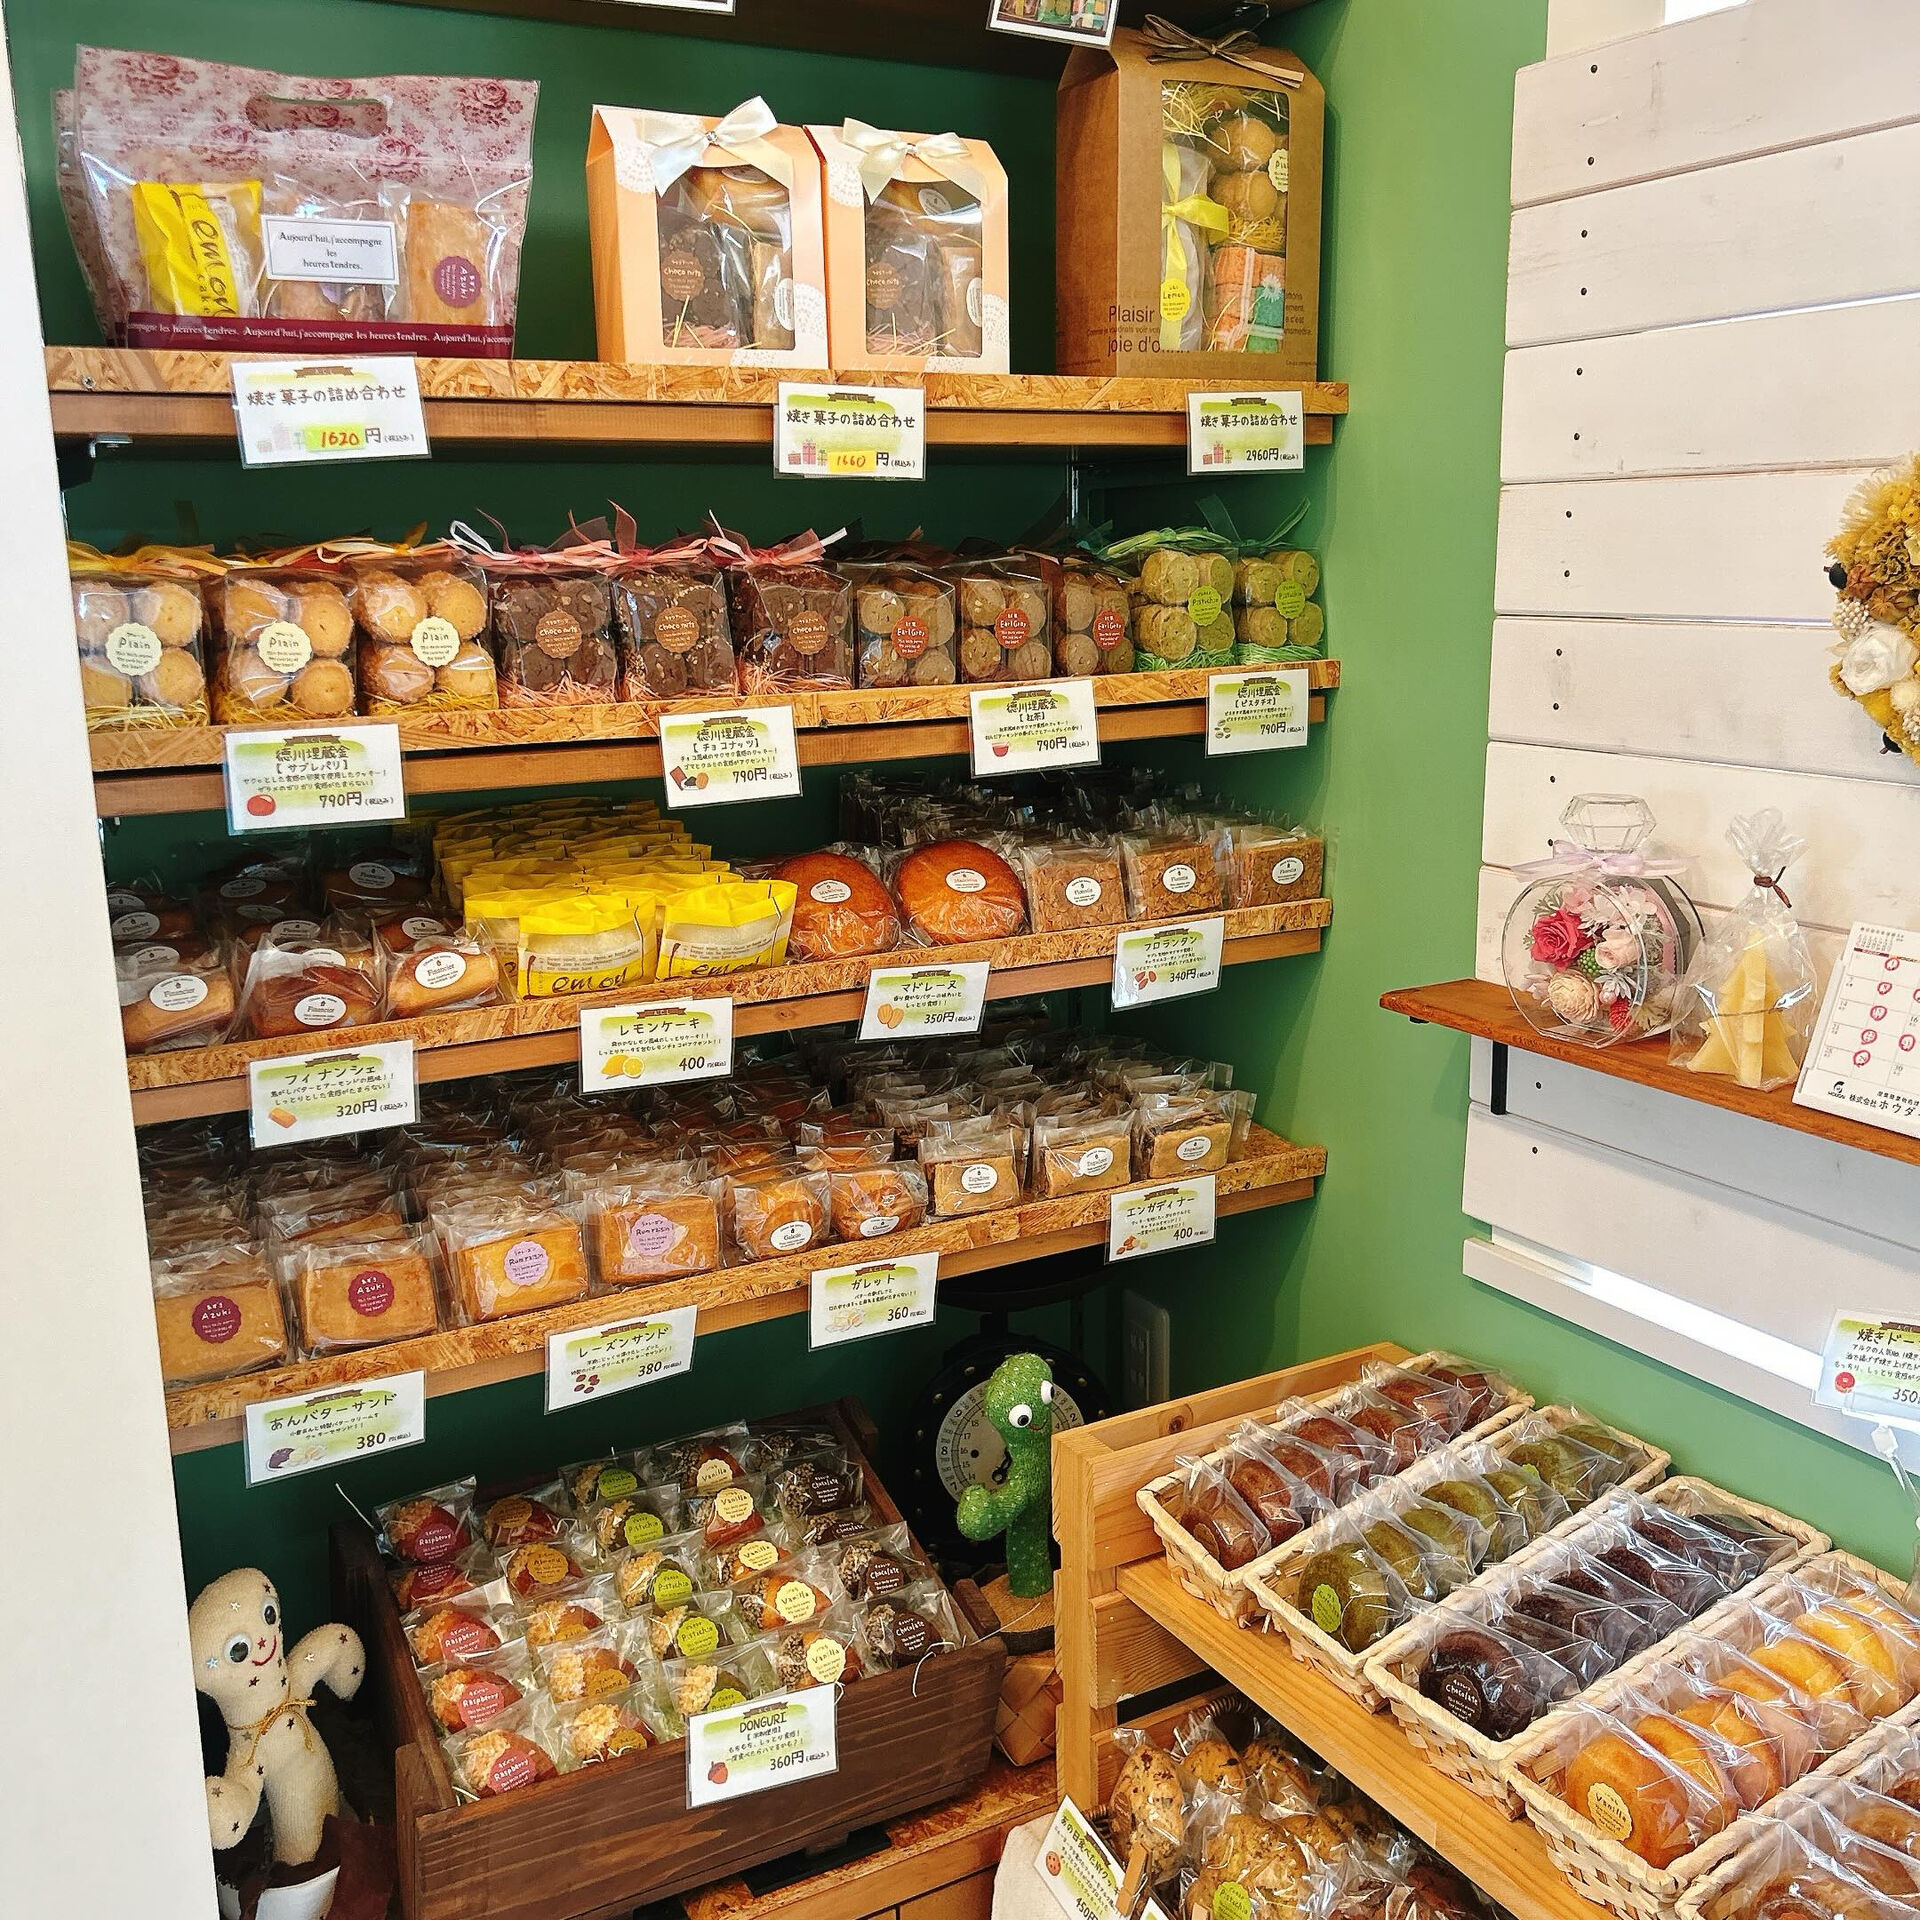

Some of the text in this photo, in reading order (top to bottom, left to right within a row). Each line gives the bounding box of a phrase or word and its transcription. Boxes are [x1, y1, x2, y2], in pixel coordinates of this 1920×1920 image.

[326, 249, 338, 258] les
[303, 258, 330, 269] heures
[1162, 289, 1186, 300] Lemon
[1108, 305, 1155, 323] Plaisir
[160, 323, 170, 332] les
[173, 324, 201, 335] heures
[202, 325, 240, 336] tendres.
[357, 330, 367, 339] les
[369, 331, 396, 341] heures
[397, 332, 430, 342] tendres.
[1108, 338, 1134, 357] joie
[247, 384, 406, 406] 焼き菓子の詰め合わせ
[786, 408, 916, 429] 焼き菓子の詰め合わせ
[1200, 413, 1298, 428] 焼き菓子の詰め合わせ
[320, 431, 359, 448] 1620
[364, 427, 381, 444] 円
[837, 455, 866, 468] 1660
[876, 451, 890, 466] 円
[1246, 447, 1279, 462] 2960円
[1000, 620, 1027, 628] Earl Grey
[119, 637, 151, 649] Plain
[269, 637, 299, 648] Plain
[422, 631, 449, 644] Plain
[1237, 684, 1282, 699] 徳川埋蔵金
[1006, 697, 1058, 713] 徳川埋蔵金
[1019, 711, 1045, 723] 【紅茶】
[696, 725, 756, 742] 徳川埋蔵金
[1260, 721, 1286, 735] 790円
[1036, 736, 1067, 752] 790円
[275, 745, 350, 762] 徳川埋蔵金
[732, 766, 767, 784] 790円
[319, 790, 362, 809] 790円
[1170, 968, 1197, 983] 340円
[900, 980, 957, 993] マドレーヌ
[923, 1011, 955, 1025] 350円
[619, 1017, 701, 1036] レモンケーキ
[678, 1056, 706, 1072] 400
[285, 1064, 377, 1086] フィナンシェ
[336, 1099, 377, 1118] 320円
[1849, 1093, 1920, 1117] 株式会社ホウダ
[1127, 1196, 1195, 1218] エンガディナー
[1173, 1227, 1193, 1241] 400
[357, 1283, 385, 1295] Azuki
[851, 1273, 895, 1291] ガレット
[201, 1308, 232, 1320] Azuki
[887, 1306, 909, 1322] 360
[579, 1327, 669, 1358] レーズンサンド
[1857, 1327, 1920, 1346] 焼きドー
[637, 1361, 662, 1377] 380
[1892, 1388, 1920, 1404] 350
[270, 1393, 398, 1431] あんバターサンド
[1069, 1412, 1078, 1423] 2
[356, 1432, 386, 1449] 380
[941, 1445, 948, 1456] 8
[702, 1467, 727, 1483] Vanilla
[720, 1494, 748, 1505] Vanilla
[743, 1544, 771, 1559] Vanilla
[781, 1590, 809, 1605] Vanilla
[445, 1630, 479, 1647] Raspberry
[812, 1649, 840, 1664] Vanilla
[462, 1692, 499, 1708] Raspberry
[1445, 1684, 1478, 1706] Chocolate
[739, 1712, 788, 1734] DONGURI
[770, 1749, 805, 1771] 360円
[494, 1759, 529, 1781] Raspberry
[1595, 1793, 1627, 1823] Vanilla
